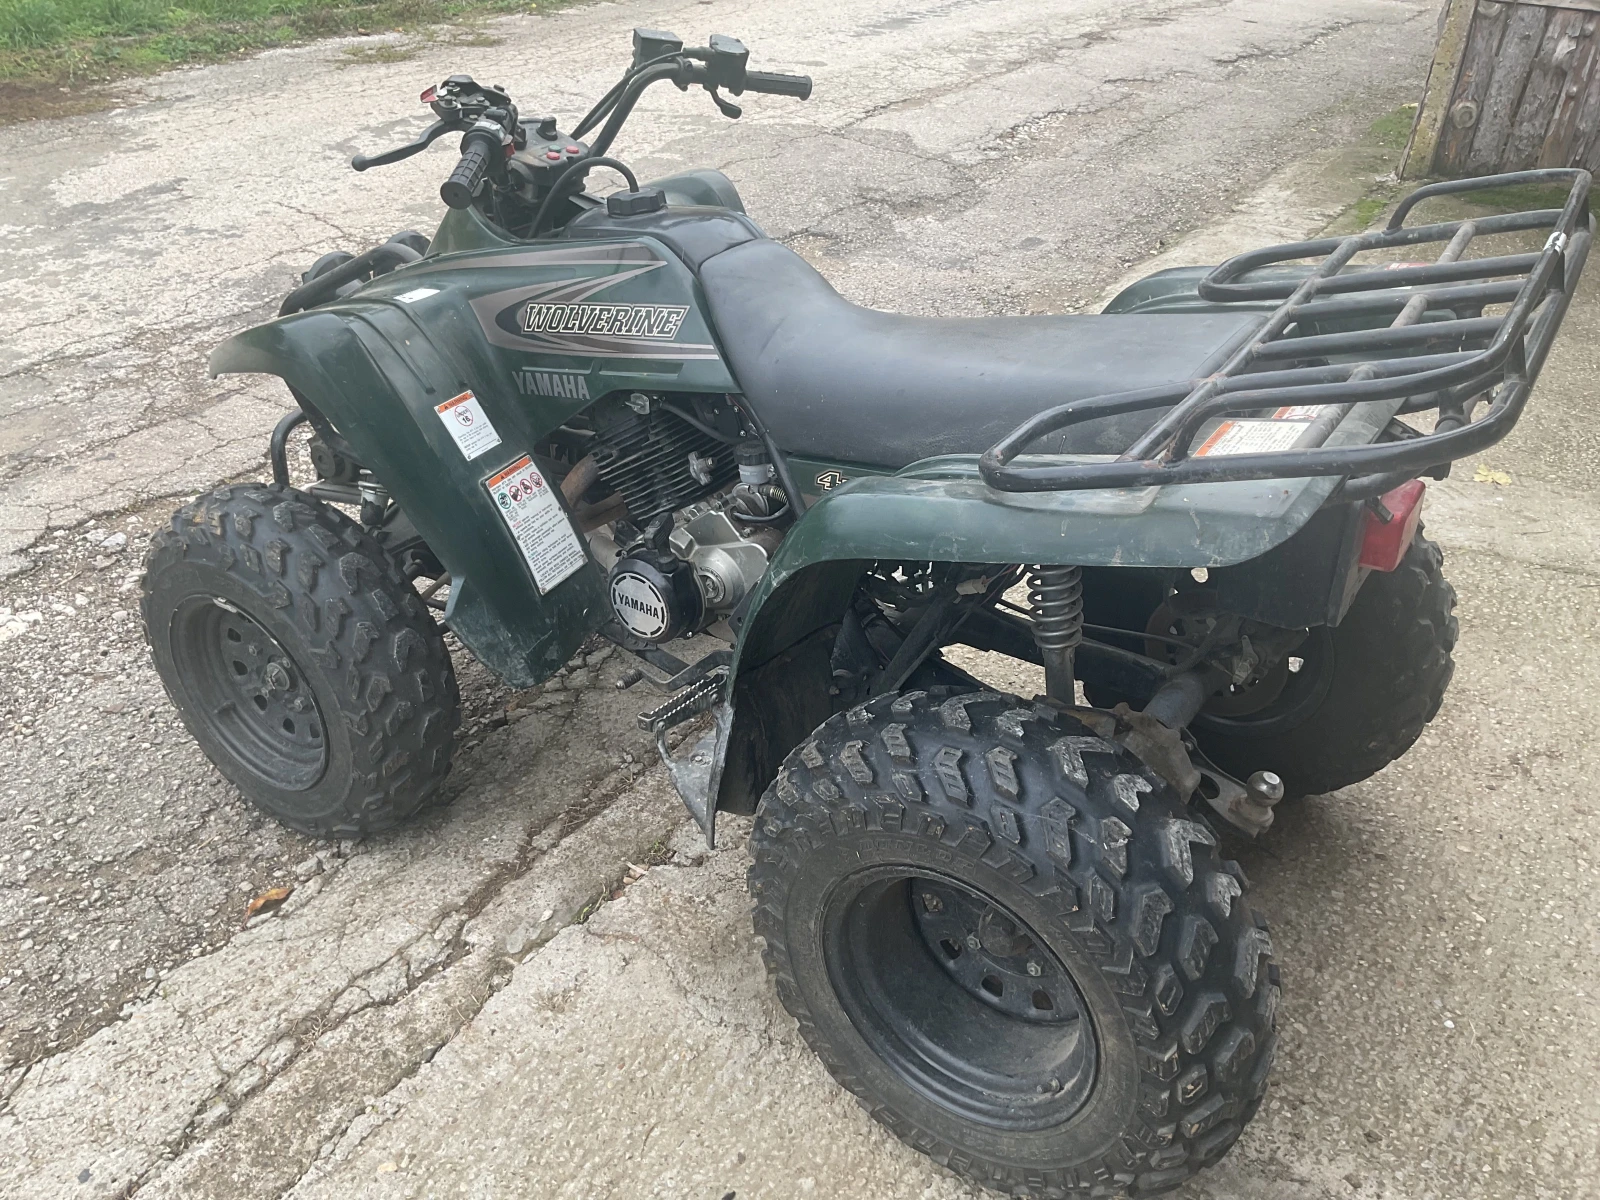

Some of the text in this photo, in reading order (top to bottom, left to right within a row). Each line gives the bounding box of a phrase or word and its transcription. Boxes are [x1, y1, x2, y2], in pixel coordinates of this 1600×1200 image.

[523, 303, 687, 337] WOLVERINE
[512, 371, 591, 400] YAMAHA
[618, 592, 660, 620] YAMAHA
